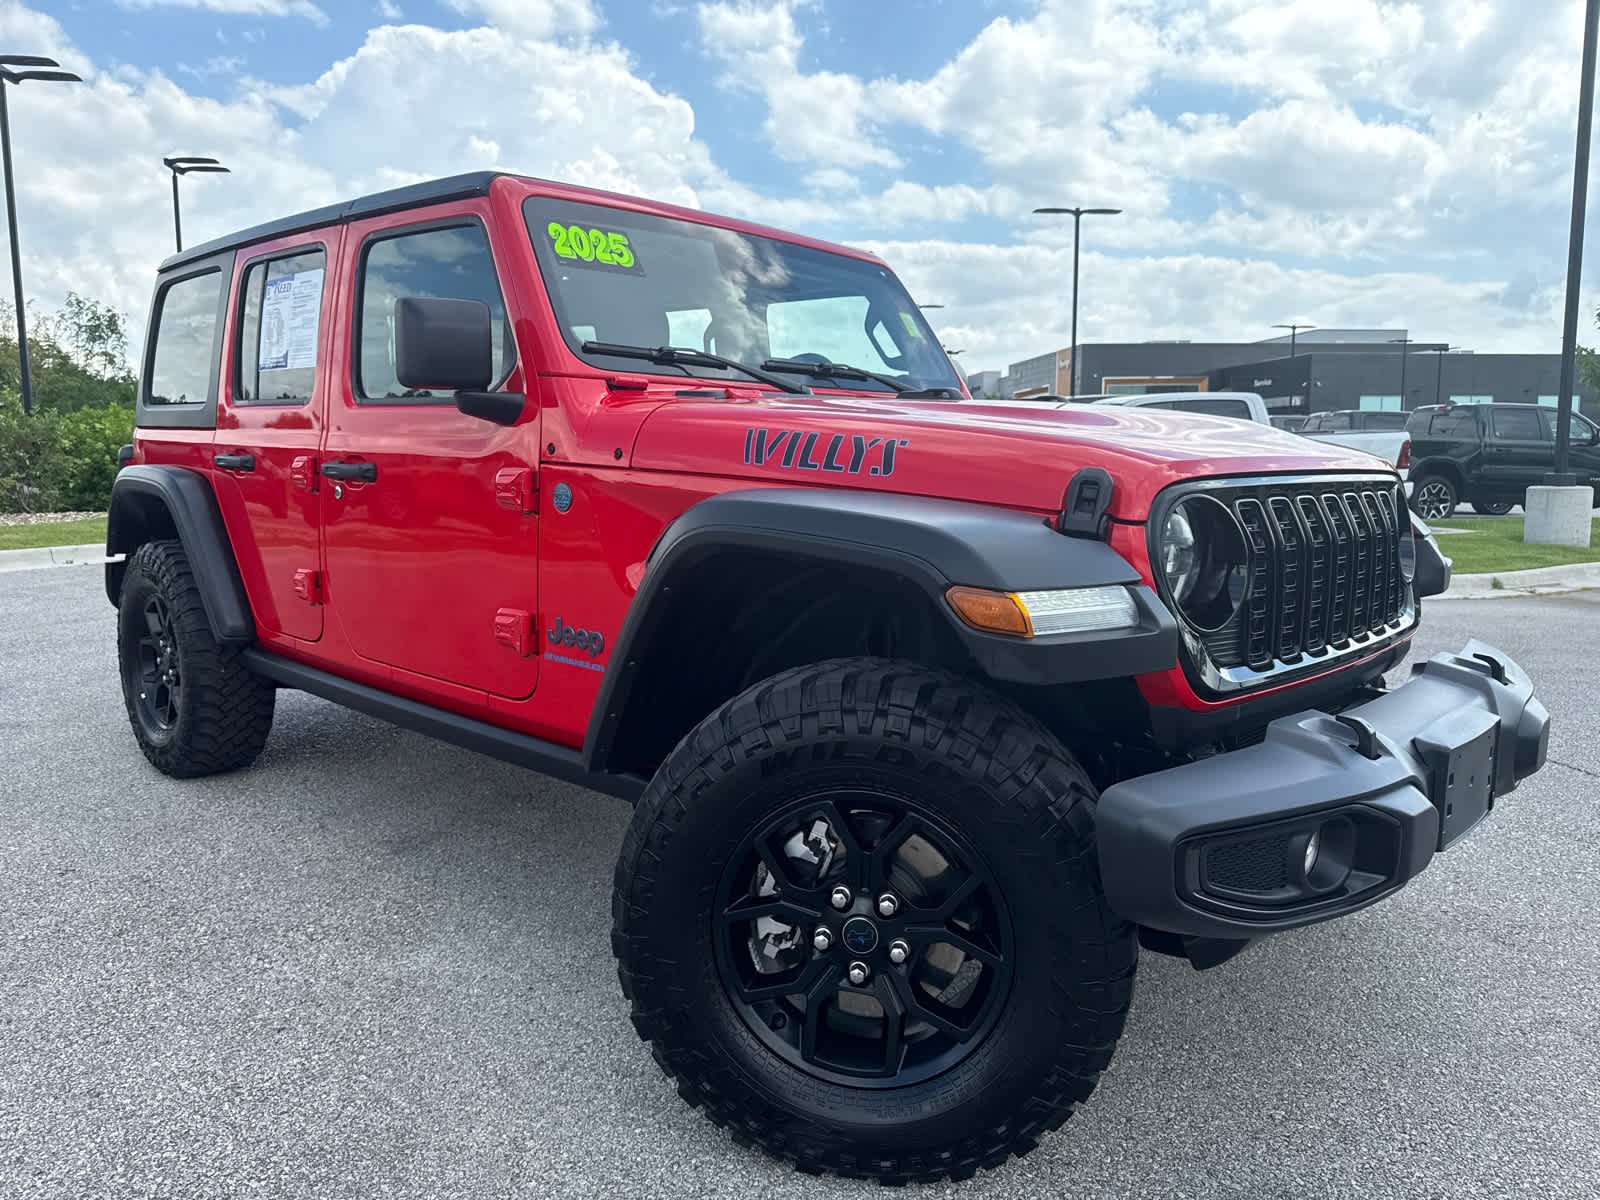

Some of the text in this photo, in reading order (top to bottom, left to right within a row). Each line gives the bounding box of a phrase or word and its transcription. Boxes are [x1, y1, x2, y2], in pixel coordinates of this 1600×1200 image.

[547, 222, 635, 268] 2025
[743, 427, 909, 477] WILLYS
[546, 616, 605, 658] Jeep
